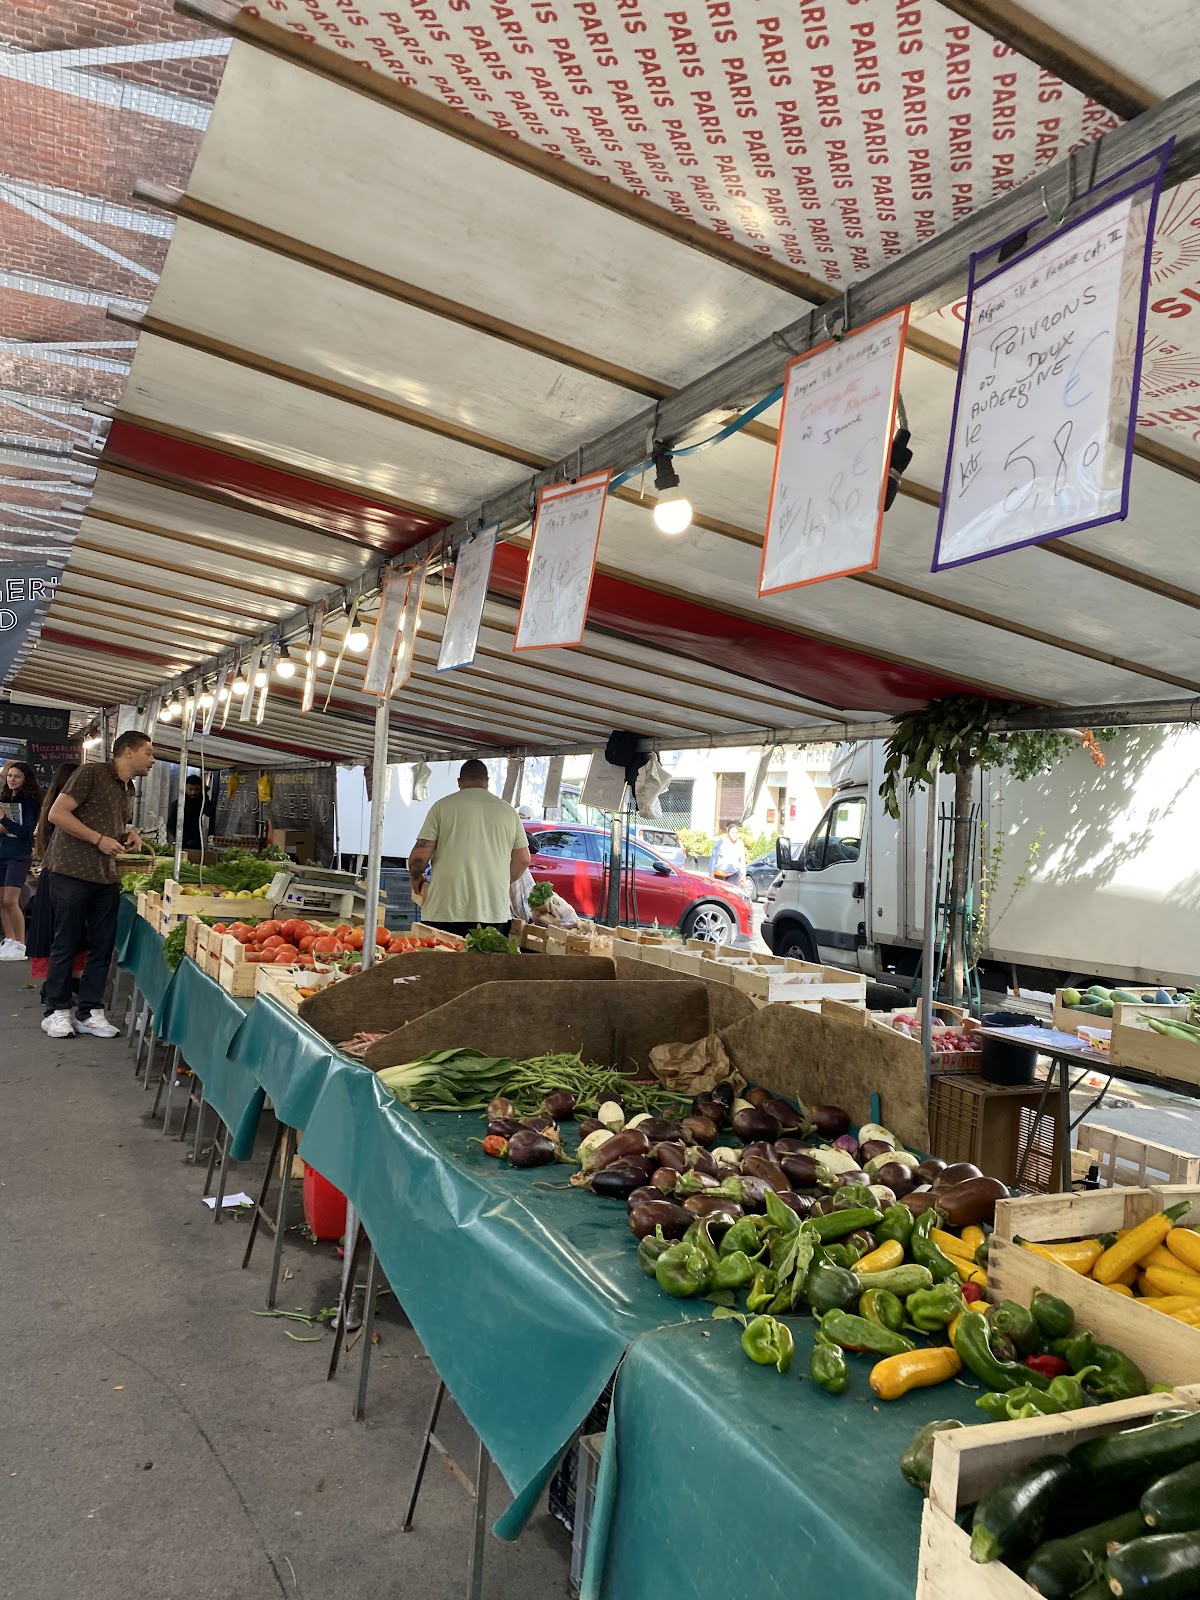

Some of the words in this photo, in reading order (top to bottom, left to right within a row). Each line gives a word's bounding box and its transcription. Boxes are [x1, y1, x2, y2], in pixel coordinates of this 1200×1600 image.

[336, 0, 369, 26] RIS
[379, 11, 433, 65] PARIS
[617, 0, 648, 34] RIS
[707, 0, 739, 44] RIS
[799, 0, 830, 51] ARIS
[896, 0, 924, 55] ARIS
[410, 0, 451, 42] ARIS
[444, 53, 493, 104] PARIS
[488, 111, 519, 141] PAR
[463, 25, 512, 80] PARIS
[505, 90, 549, 135] PARIS
[490, 0, 534, 55] ARIS
[524, 66, 570, 117] PARIS
[562, 126, 602, 166] PARIS
[632, 47, 675, 108] PARIS
[849, 21, 881, 95] PARIS
[945, 26, 972, 101] PARIS
[572, 1, 619, 67] PARIS
[607, 79, 648, 132] PARIS
[636, 142, 673, 183] PARIS
[663, 9, 705, 78] PARIS
[689, 90, 727, 144] PARIS
[712, 155, 746, 197] PARIS
[721, 57, 759, 119] PARIS
[810, 64, 843, 128] PARIS
[900, 69, 928, 137] PARIS
[992, 72, 1018, 141] PARIS
[547, 37, 593, 95] PARIS
[583, 105, 623, 152] PARIS
[614, 160, 650, 199] PARIS
[662, 119, 699, 166] PARIS
[755, 16, 792, 88] PARIS
[774, 100, 808, 155] PARIS
[792, 165, 822, 210] PARIS
[808, 218, 832, 252] PARIS
[860, 107, 890, 165] PARIS
[948, 113, 972, 173] PARIS
[742, 129, 776, 178] PARIS
[824, 139, 854, 188] PARIS
[907, 149, 932, 201] PARIS
[688, 175, 720, 212] PARIS
[762, 187, 791, 226] PARIS
[838, 197, 864, 239] PARIS
[871, 175, 896, 222] PARIS
[711, 218, 734, 242] PAR
[779, 234, 806, 264] PARIS
[10, 712, 63, 730] DAVID
